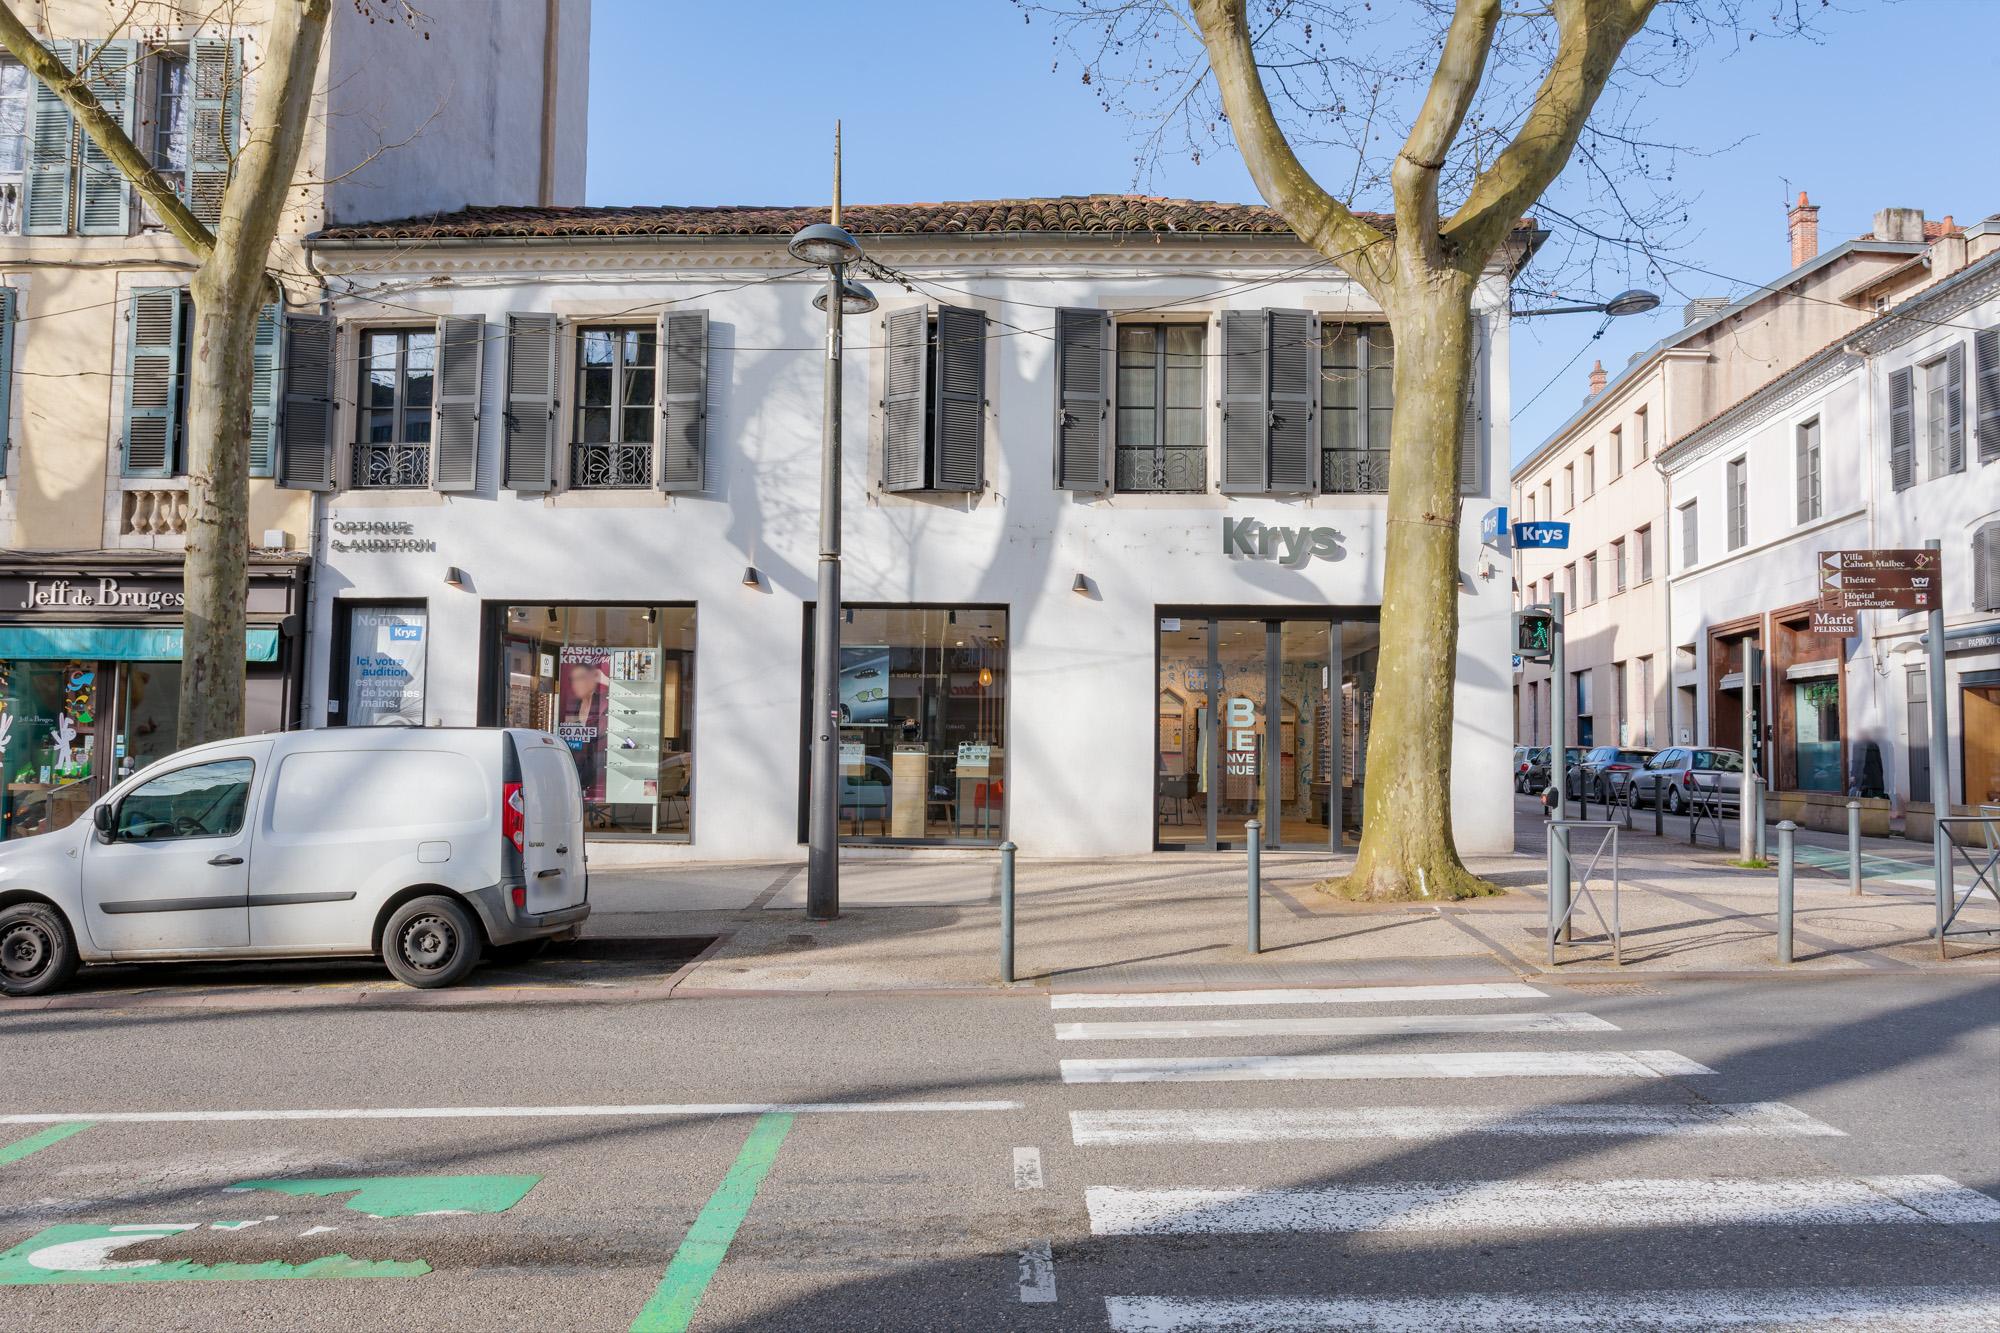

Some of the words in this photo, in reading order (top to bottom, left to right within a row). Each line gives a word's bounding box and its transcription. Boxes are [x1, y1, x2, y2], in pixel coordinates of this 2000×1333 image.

[333, 521, 409, 533] OPTIQUE
[1483, 515, 1497, 533] Krys
[1522, 526, 1563, 544] Krys
[350, 539, 432, 552] AUDITION
[1223, 516, 1342, 566] Krys
[1843, 553, 1863, 561] Villa
[1843, 559, 1873, 568] Cahors
[1875, 559, 1905, 568] Malbec
[1843, 576, 1876, 584] Théâtre
[21, 580, 72, 609] Jeff
[72, 588, 93, 605] de
[97, 577, 185, 610] Bruges
[1844, 591, 1875, 600] Hôpital
[1844, 599, 1896, 609] Jean-Rougier
[357, 614, 421, 627] Nouveau
[1814, 612, 1855, 626] Marie
[394, 627, 417, 639] Krys
[560, 646, 611, 655] FASHION
[356, 656, 373, 668] Ici,
[375, 656, 405, 666] votre
[361, 667, 408, 677] audition
[355, 679, 374, 688] est
[375, 678, 405, 688] entre
[361, 687, 376, 697] de
[378, 687, 420, 698] bonnes
[360, 699, 399, 708] mains.
[560, 728, 572, 736] 60
[575, 728, 596, 736] ANS
[1227, 753, 1256, 763] NVE
[1227, 765, 1256, 775] NUE
